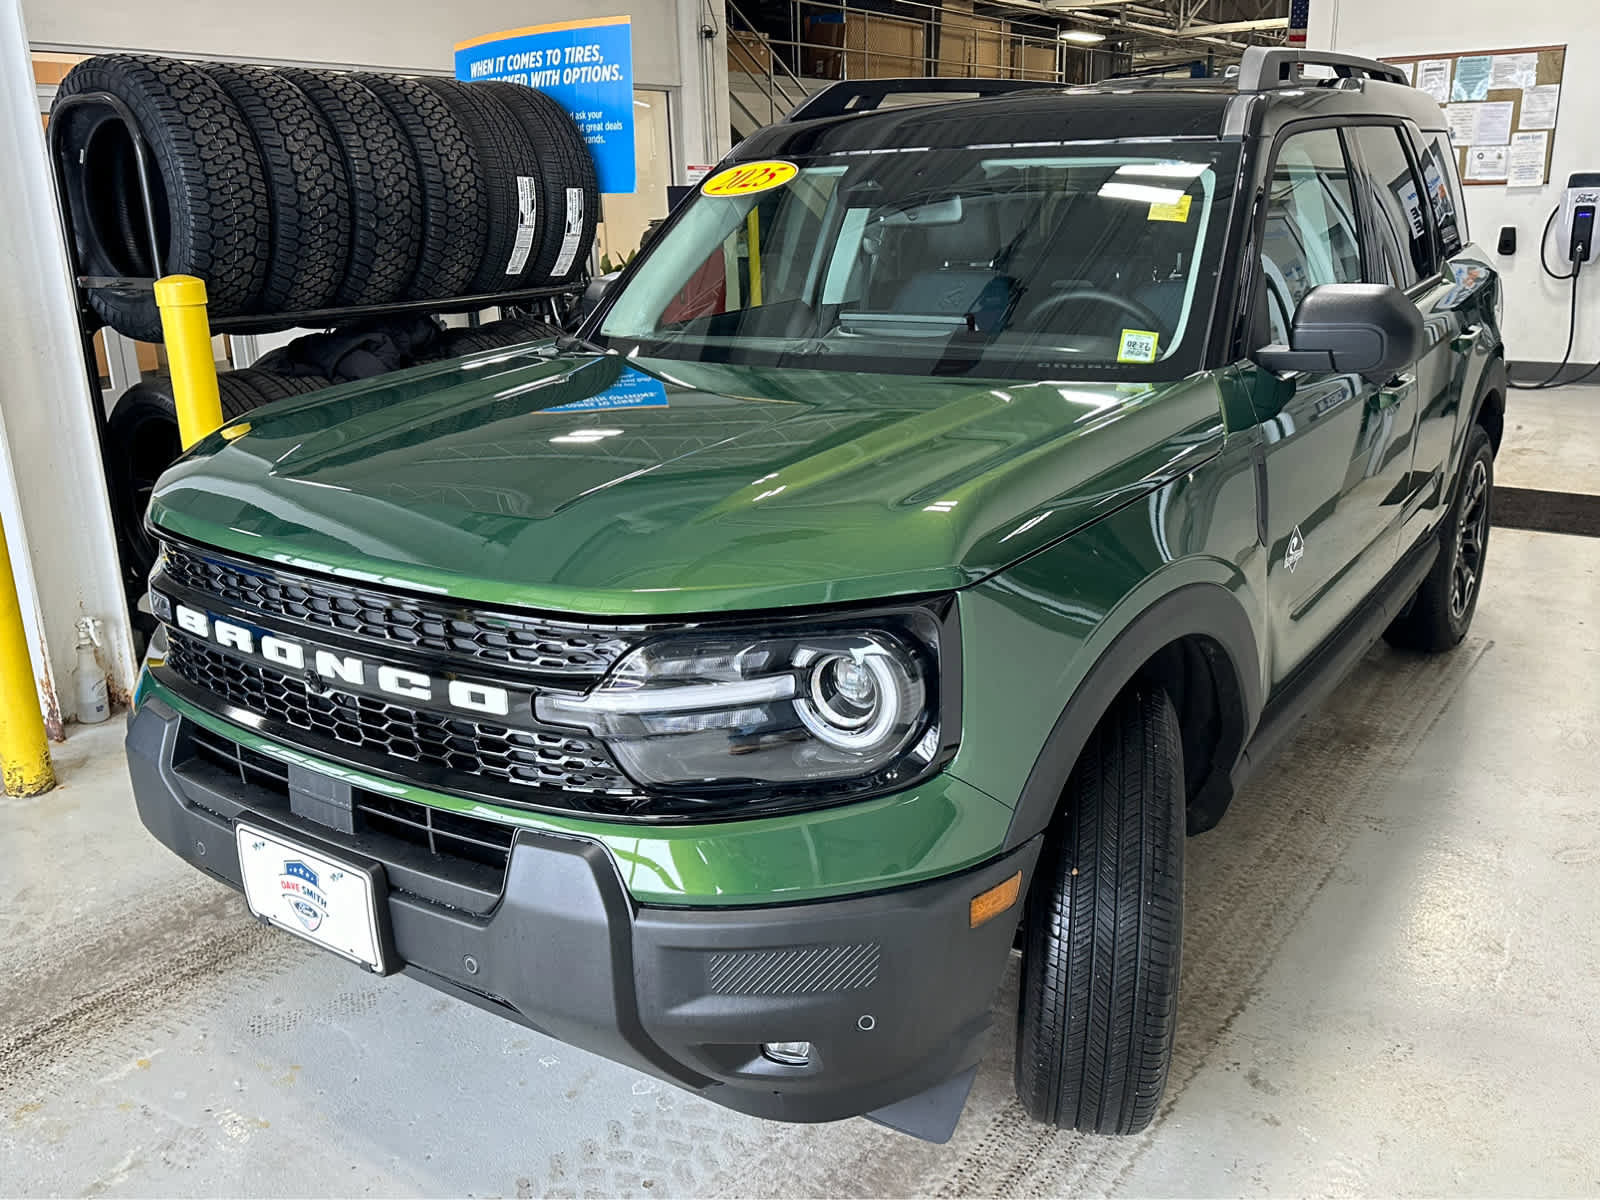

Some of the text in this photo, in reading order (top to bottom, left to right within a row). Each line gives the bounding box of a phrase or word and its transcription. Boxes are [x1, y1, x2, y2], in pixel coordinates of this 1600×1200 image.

[470, 44, 604, 79] WHEN IT COMES TO TIRES,
[530, 68, 561, 88] WITH
[562, 64, 624, 84] OPTIONS.
[575, 110, 587, 120] ask
[587, 111, 603, 121] your
[585, 122, 604, 133] great
[605, 119, 623, 131] deals
[711, 166, 789, 192] 2025
[175, 604, 510, 716] BRONCO
[281, 880, 328, 909] DAVE SMITH
